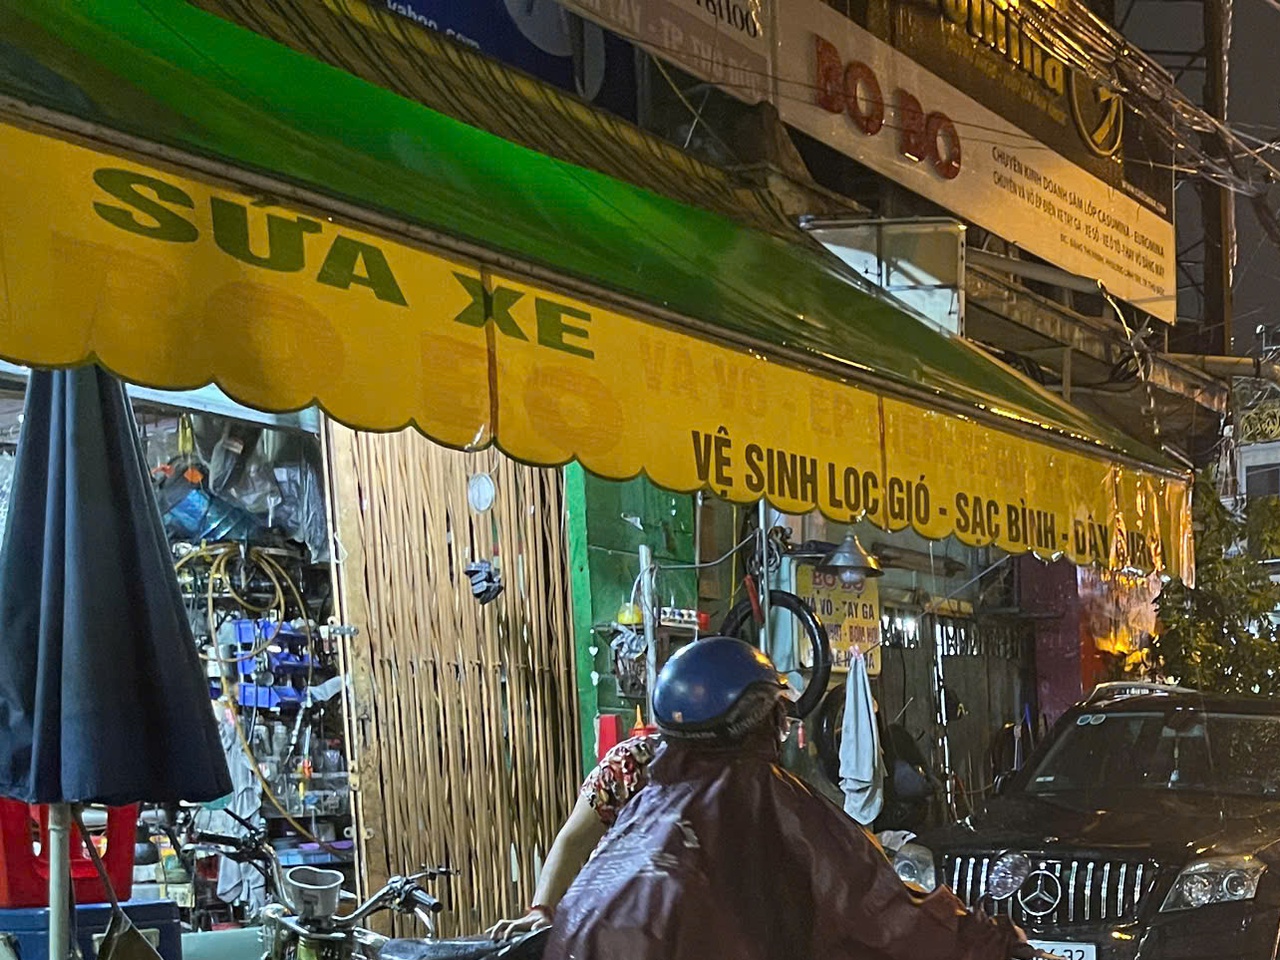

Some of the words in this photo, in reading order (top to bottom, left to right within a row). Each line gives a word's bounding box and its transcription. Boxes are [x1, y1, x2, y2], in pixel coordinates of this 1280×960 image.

[814, 33, 884, 136] BO
[894, 86, 961, 180] BO
[451, 270, 596, 360] XE
[691, 425, 734, 497] VỆ
[745, 444, 818, 504] SINH
[828, 462, 879, 521] LỌC
[888, 474, 931, 526] GIÓ
[955, 491, 1000, 543] SẠC
[1007, 498, 1056, 550] BÌNH
[1073, 513, 1110, 561] DÂY
